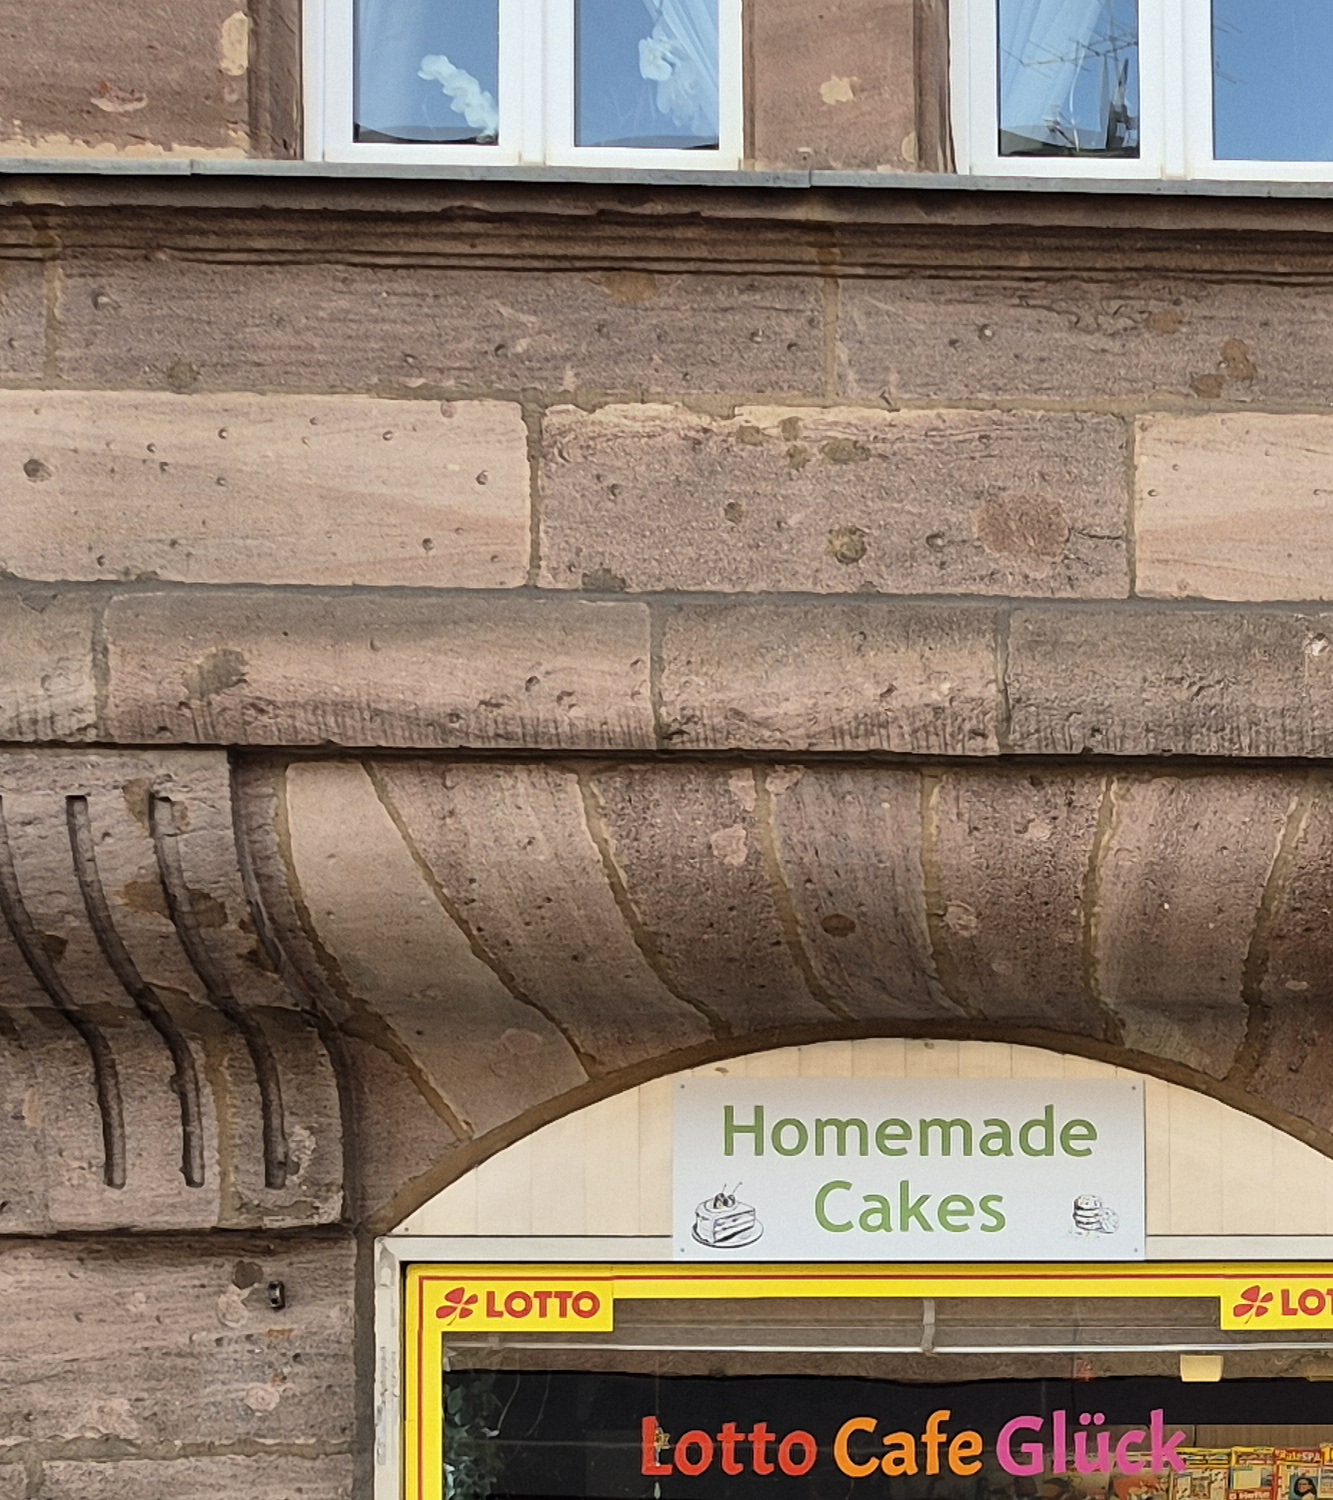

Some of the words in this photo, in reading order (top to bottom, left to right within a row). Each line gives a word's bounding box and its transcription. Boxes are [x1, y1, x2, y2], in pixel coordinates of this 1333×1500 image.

[722, 1103, 1097, 1158] Homemade
[814, 1179, 1006, 1233] Cakes
[485, 1291, 600, 1319] LOTTO
[640, 1415, 817, 1477] Lotto
[833, 1409, 983, 1477] Cafe
[996, 1409, 1188, 1476] Glück
